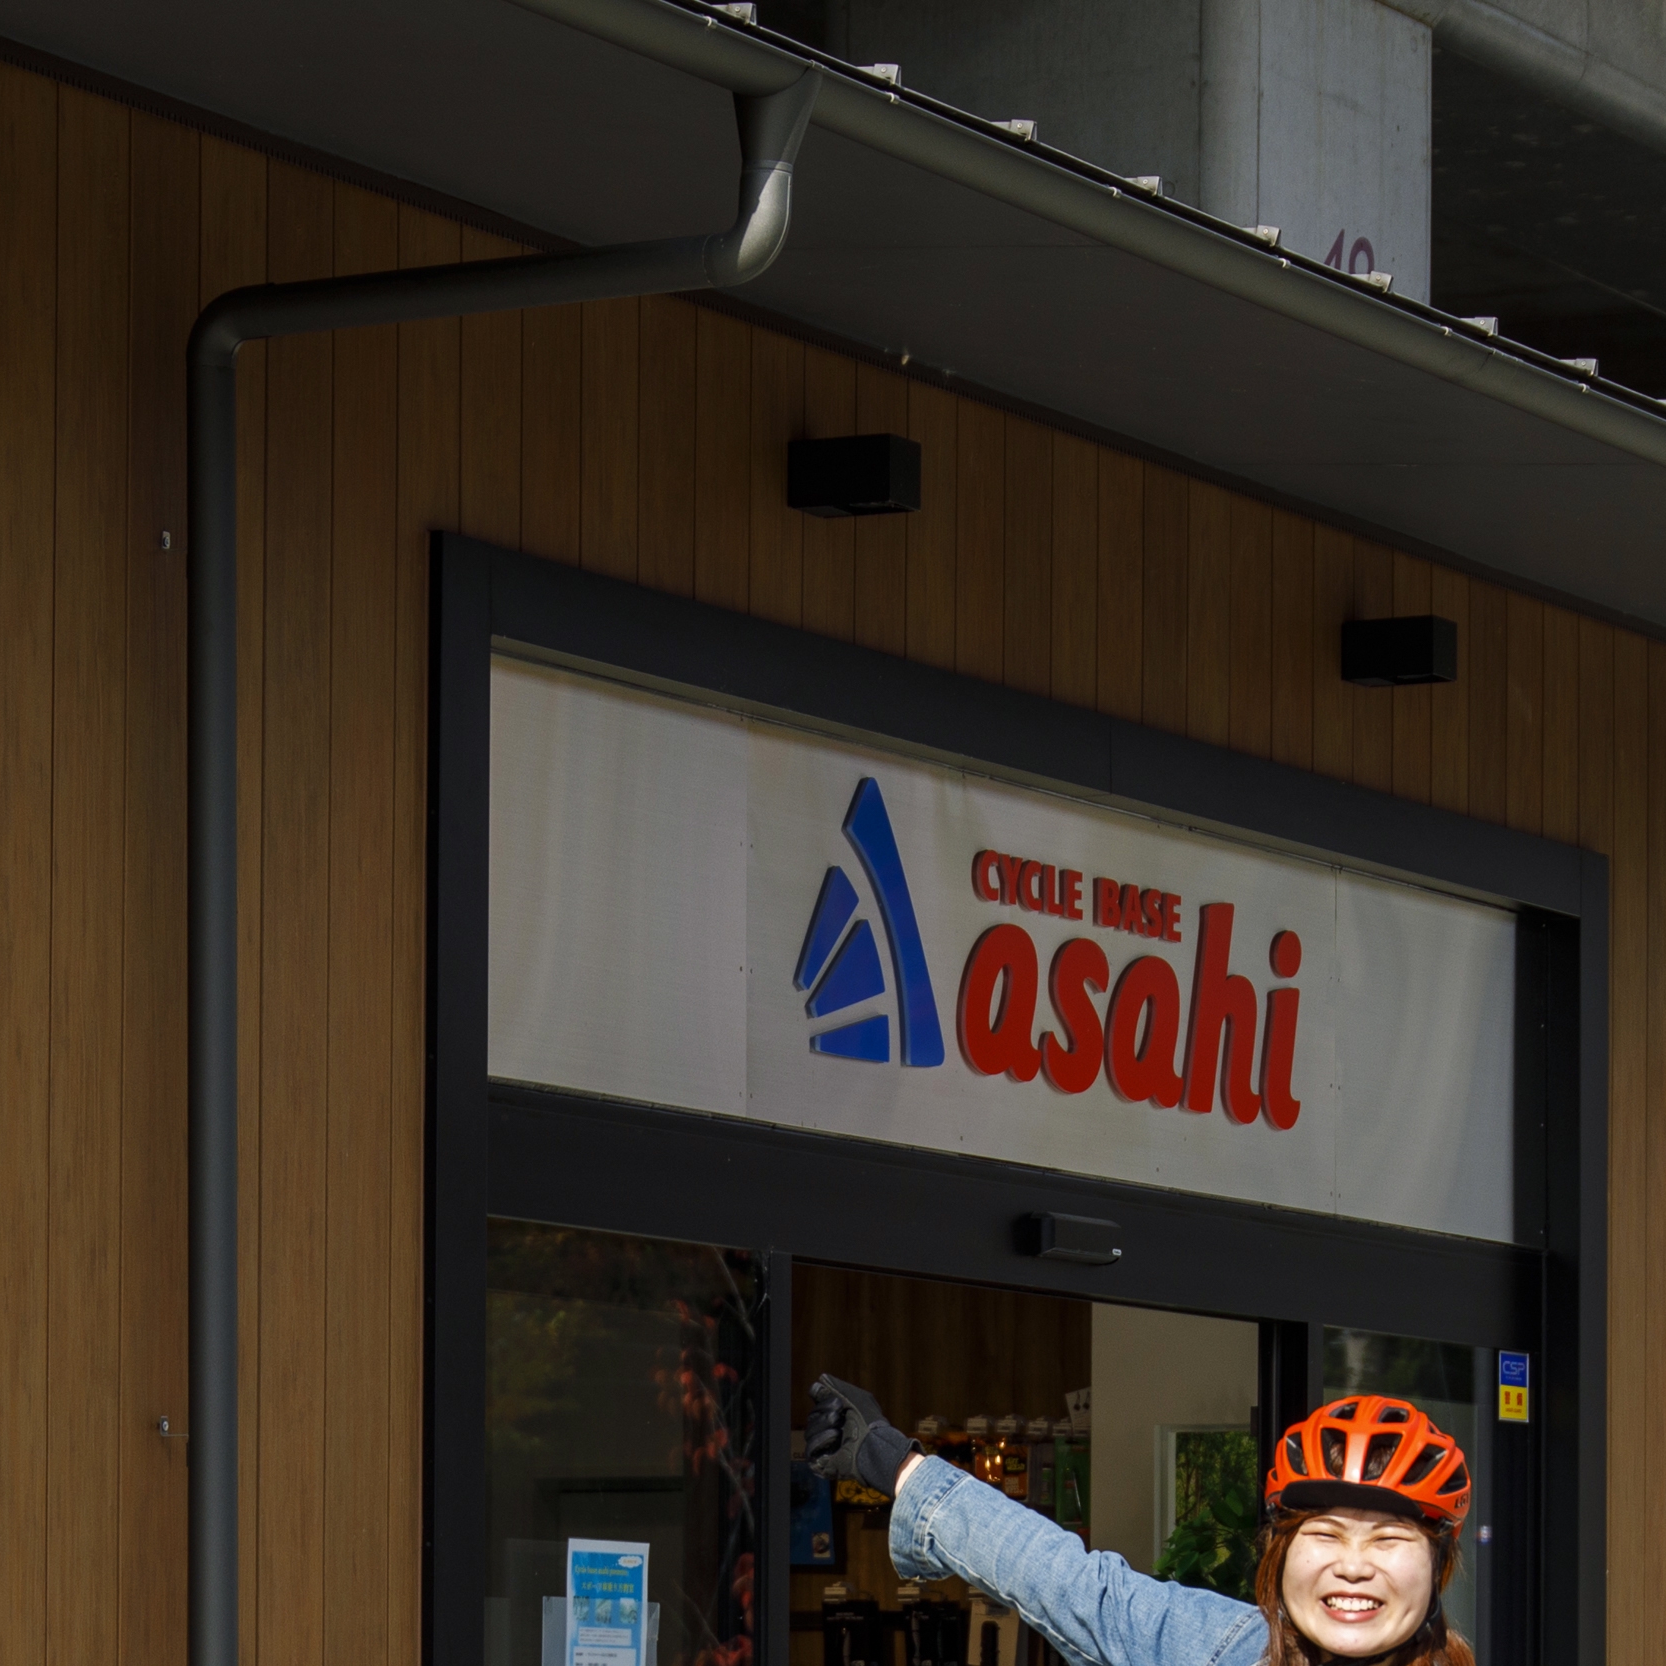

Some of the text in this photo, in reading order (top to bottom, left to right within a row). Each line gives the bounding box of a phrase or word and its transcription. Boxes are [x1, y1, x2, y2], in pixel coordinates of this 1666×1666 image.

[972, 849, 1183, 943] CYCLE BASE
[956, 902, 1302, 1130] asahi
